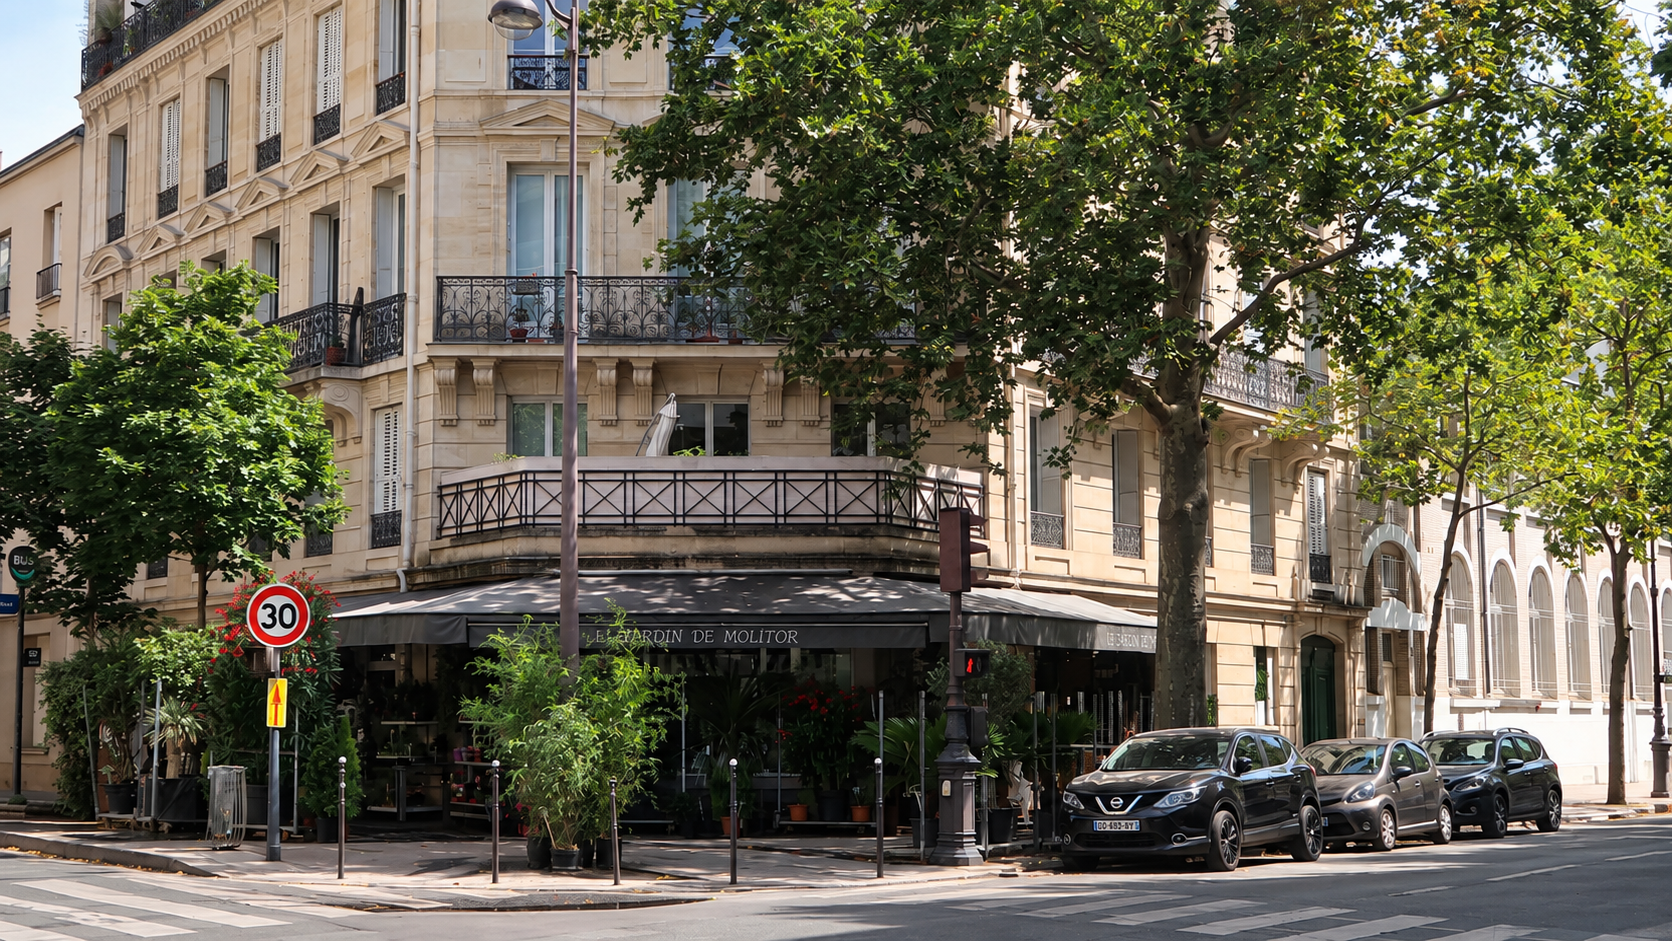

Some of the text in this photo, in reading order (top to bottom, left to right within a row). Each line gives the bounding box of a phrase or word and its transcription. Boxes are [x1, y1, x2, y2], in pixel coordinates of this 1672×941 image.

[13, 555, 34, 566] BUS
[260, 603, 297, 630] 30
[691, 629, 715, 644] DE
[723, 628, 798, 644] MOLITOR
